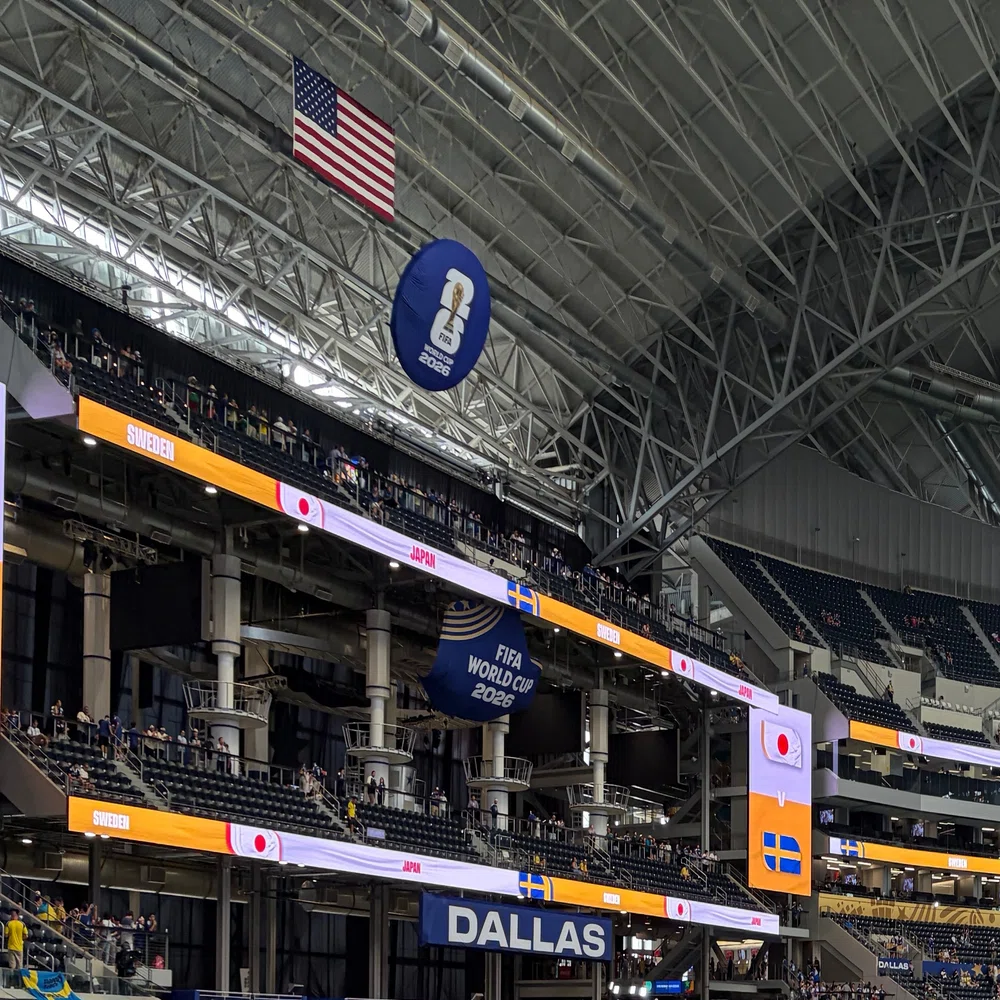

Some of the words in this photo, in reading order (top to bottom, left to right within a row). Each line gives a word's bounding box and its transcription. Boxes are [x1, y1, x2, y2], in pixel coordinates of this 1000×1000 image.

[438, 332, 452, 346] FIFA
[418, 351, 451, 377] 2026
[423, 343, 444, 360] WORLD
[442, 355, 454, 365] CUP
[127, 423, 175, 462] SWEDEN
[410, 546, 436, 569] JAPAN
[596, 622, 620, 645] SWEDEN
[495, 643, 522, 671] FIFA
[467, 654, 513, 687] WORLD
[512, 675, 534, 694] CUP
[471, 682, 515, 708] 2026
[738, 685, 753, 700] JAPAN
[92, 810, 130, 830] SWEDEN
[402, 860, 421, 875] JAPAN
[948, 857, 968, 869] SWEDEN
[448, 905, 605, 958] DALLAS
[878, 960, 909, 971] DALLAS
